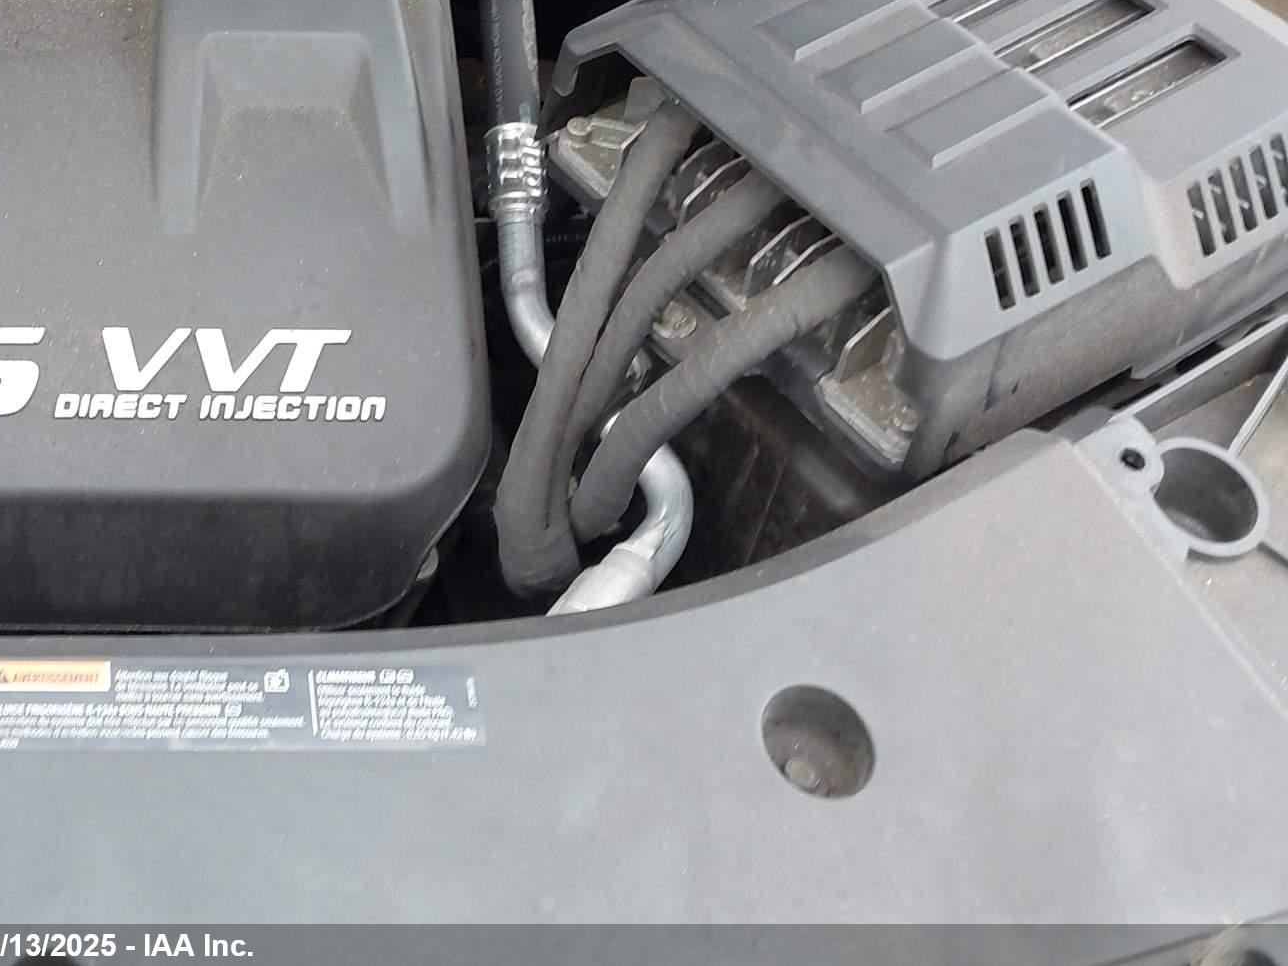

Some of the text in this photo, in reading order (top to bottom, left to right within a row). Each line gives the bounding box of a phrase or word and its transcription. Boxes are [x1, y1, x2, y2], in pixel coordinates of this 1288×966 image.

[102, 327, 352, 393] VVT
[54, 393, 386, 422] DIRECT INJECTION
